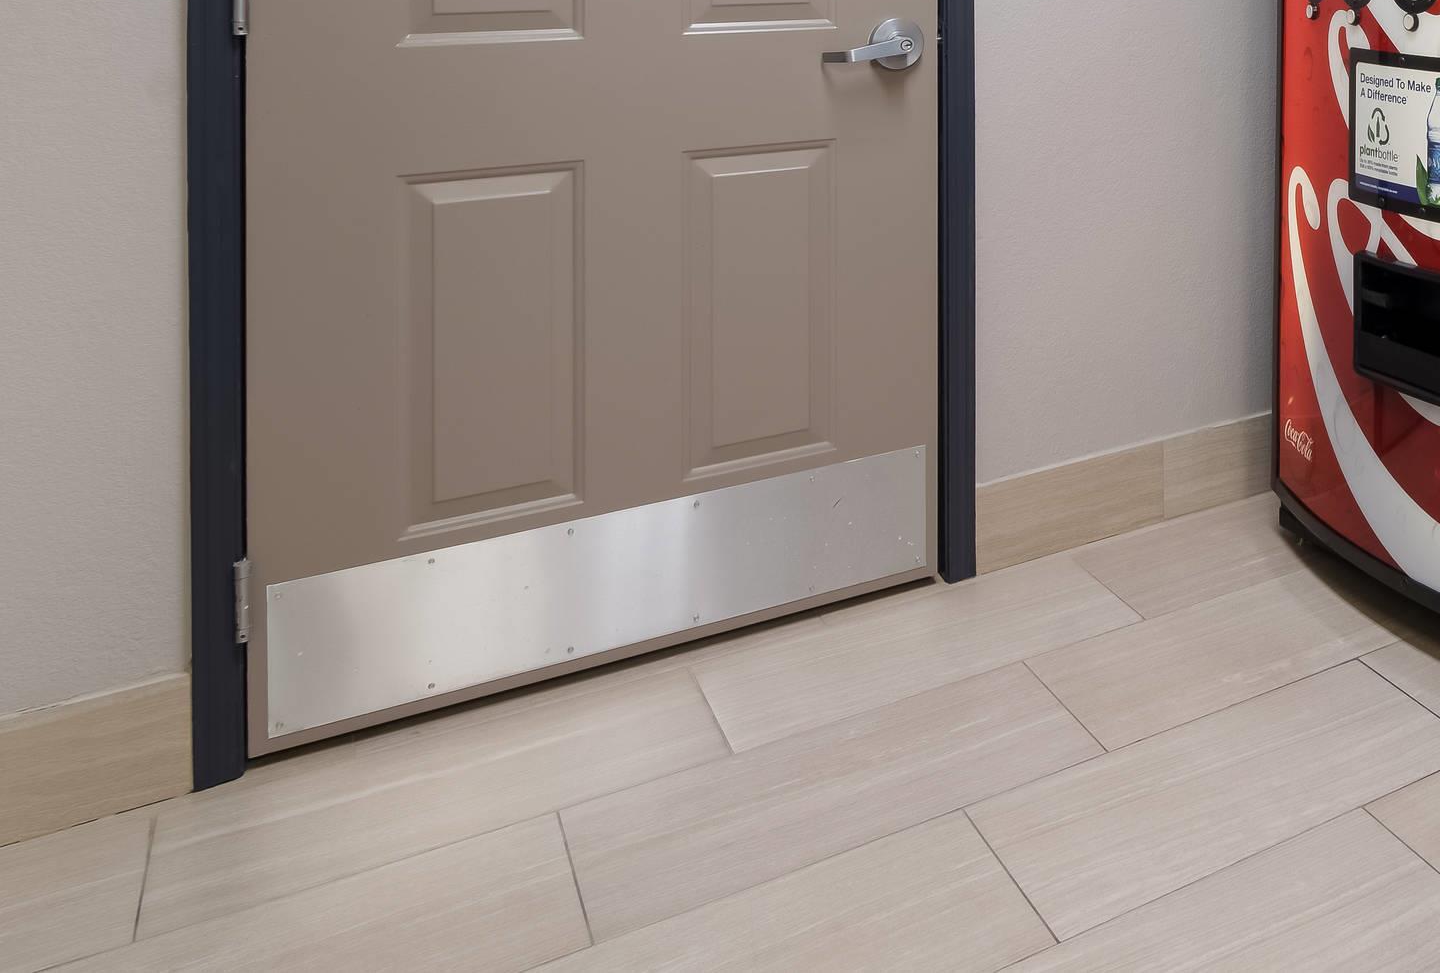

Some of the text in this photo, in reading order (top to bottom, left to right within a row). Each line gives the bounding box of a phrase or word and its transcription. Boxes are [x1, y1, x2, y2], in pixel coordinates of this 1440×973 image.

[1360, 72, 1432, 93] Designed To Make
[1360, 87, 1407, 105] A Difference
[1359, 144, 1399, 163] plantbottle
[1284, 418, 1314, 462] Coca-Cola
